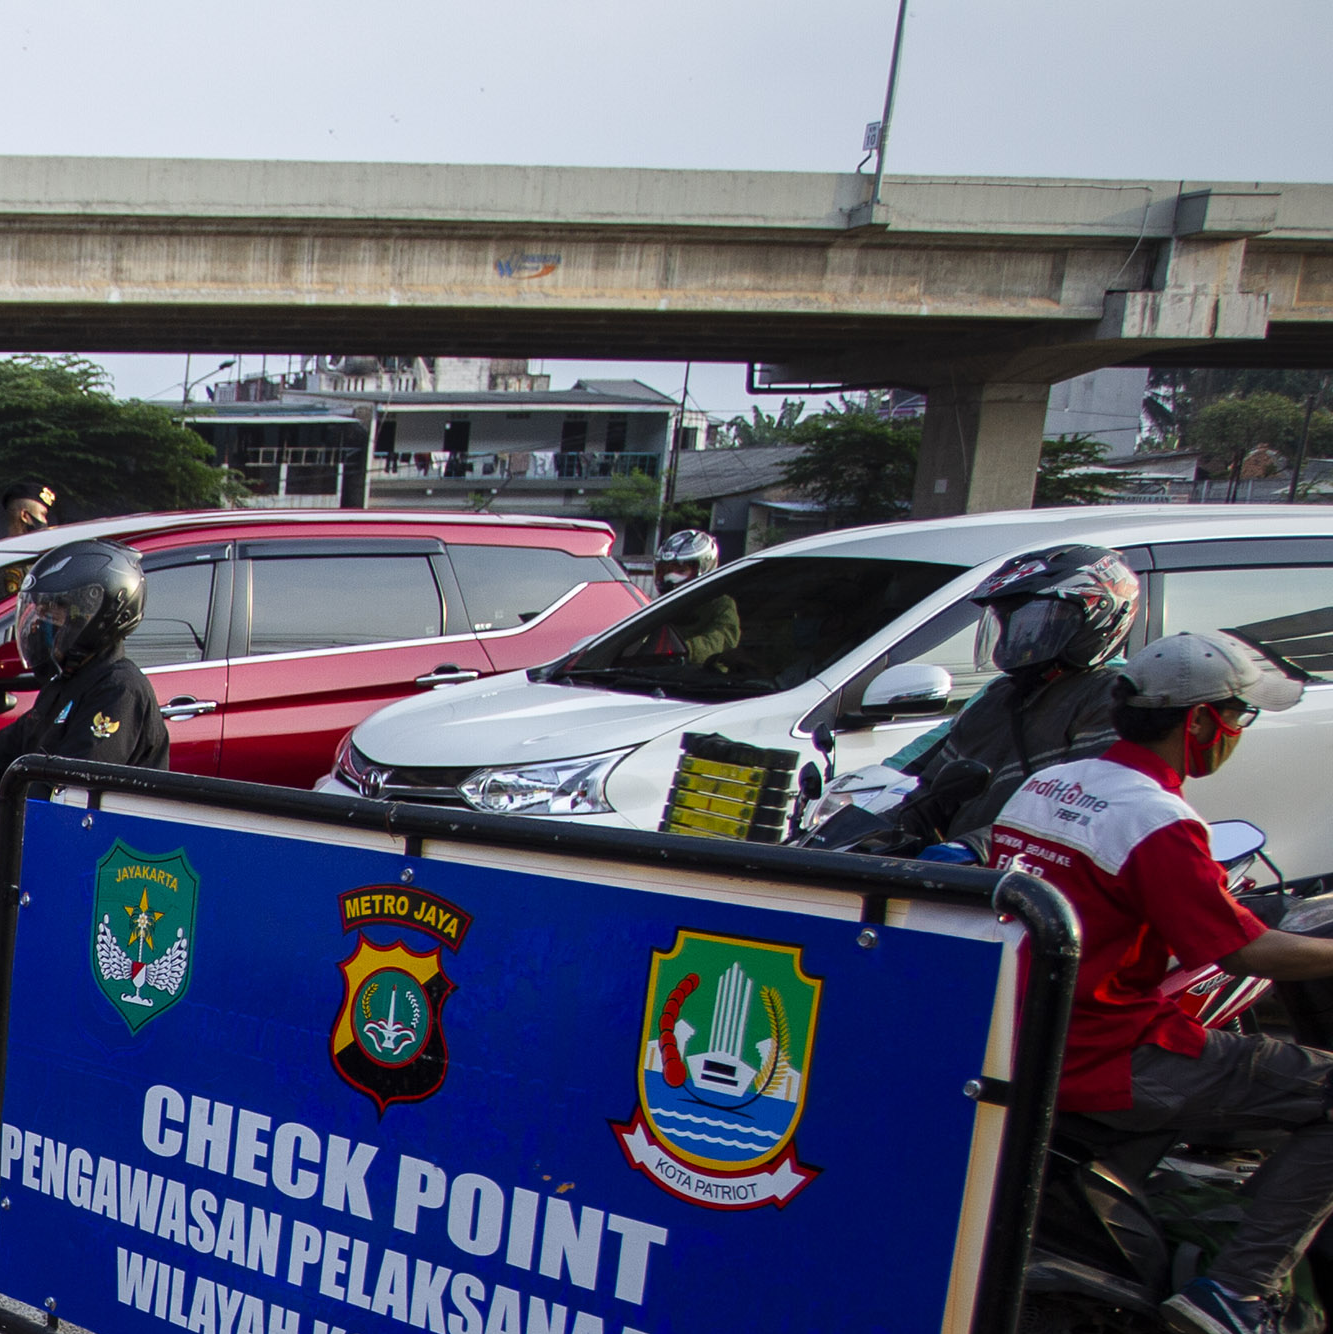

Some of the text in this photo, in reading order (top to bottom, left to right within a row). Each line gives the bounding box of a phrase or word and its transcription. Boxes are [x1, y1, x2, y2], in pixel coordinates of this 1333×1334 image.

[115, 864, 179, 893] JAYAKARTA
[344, 894, 459, 939] METRO JAYA
[0, 1122, 282, 1277] PENGAWASAN
[141, 1084, 668, 1306] CHECK POINT
[655, 1157, 758, 1200] KOTA PATRIOT
